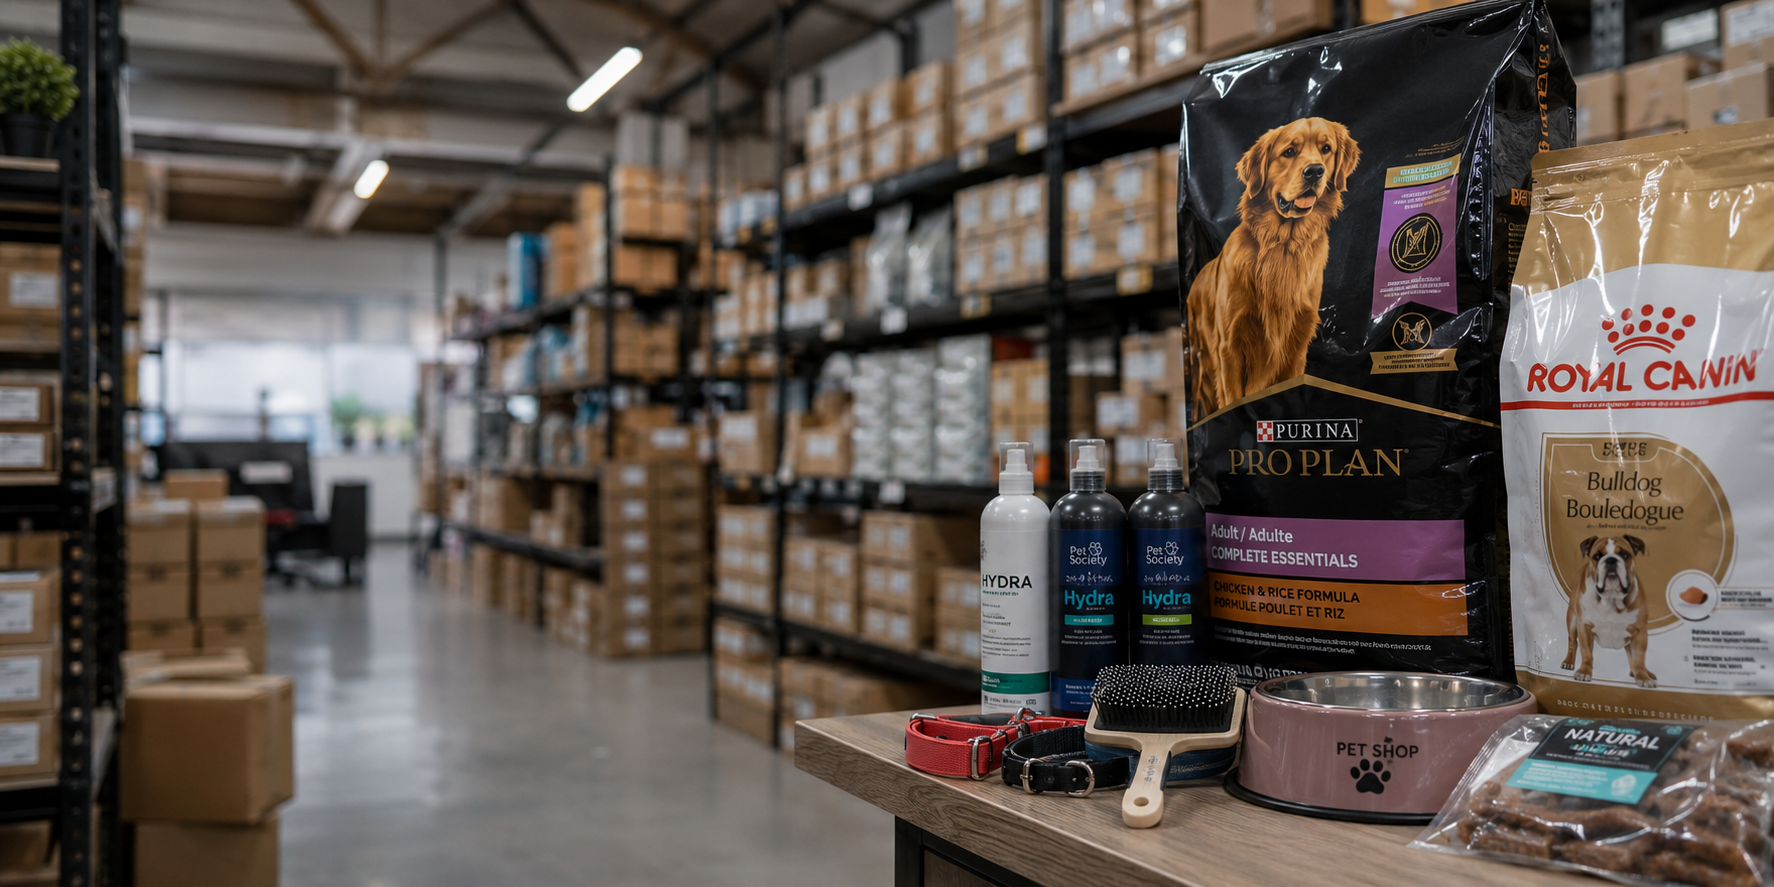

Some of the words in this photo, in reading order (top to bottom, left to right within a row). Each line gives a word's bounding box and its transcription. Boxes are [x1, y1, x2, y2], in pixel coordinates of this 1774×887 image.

[1527, 361, 1632, 393] ROYAL
[1643, 349, 1757, 391] CANIN
[1276, 423, 1353, 439] PURINA
[1228, 449, 1292, 476] PRO
[1299, 449, 1403, 476] PLAN
[1587, 470, 1663, 498] Bulldog
[1566, 497, 1685, 526] Bouledogue
[1211, 523, 1239, 540] Adult
[1249, 527, 1293, 543] Adulte
[1069, 545, 1087, 556] Pet
[1069, 555, 1107, 567] Society
[1146, 545, 1163, 556] Pet
[1146, 554, 1184, 566] Society
[1211, 546, 1268, 564] COMPLETE
[1271, 550, 1359, 568] ESSENTIALS
[982, 575, 1033, 589] HYDRA
[1213, 580, 1255, 596] CHICKEN
[1257, 586, 1266, 597] &
[1268, 587, 1295, 600] RICE
[1297, 588, 1361, 604] FORMULA
[1064, 589, 1115, 611] Hydra
[1142, 589, 1192, 610] Hydra
[1214, 596, 1257, 612] FORMULE
[1259, 602, 1303, 617] POULET
[1306, 606, 1321, 618] ET
[1324, 608, 1345, 620] RIZ
[1564, 728, 1660, 750] NATURAL
[1337, 742, 1367, 756] PET
[1372, 743, 1419, 759] SHOP
